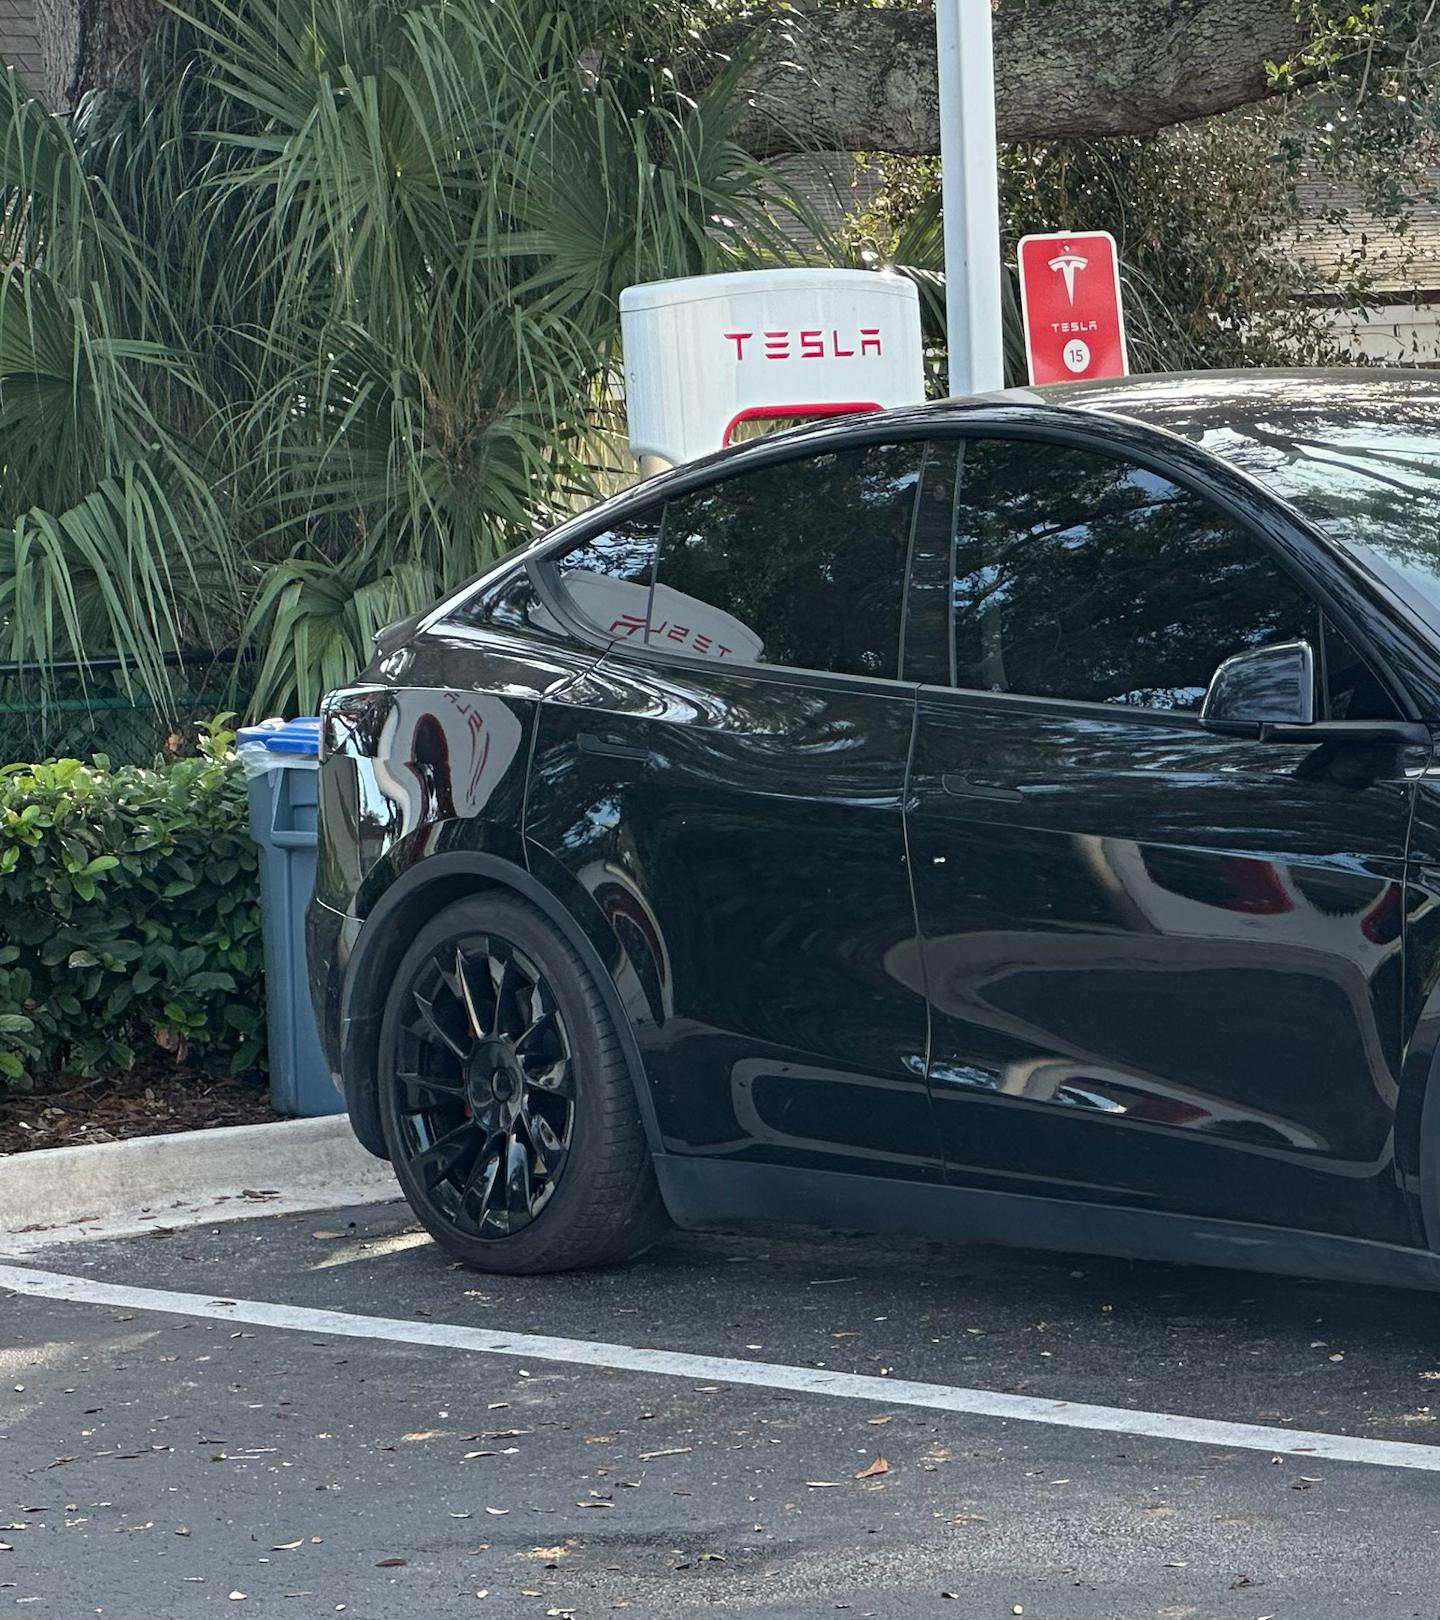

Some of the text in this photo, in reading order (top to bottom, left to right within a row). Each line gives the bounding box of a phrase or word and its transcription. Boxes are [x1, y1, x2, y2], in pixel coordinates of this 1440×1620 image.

[1051, 320, 1098, 333] TESLA
[723, 328, 882, 361] TESLA
[1069, 349, 1084, 363] 15
